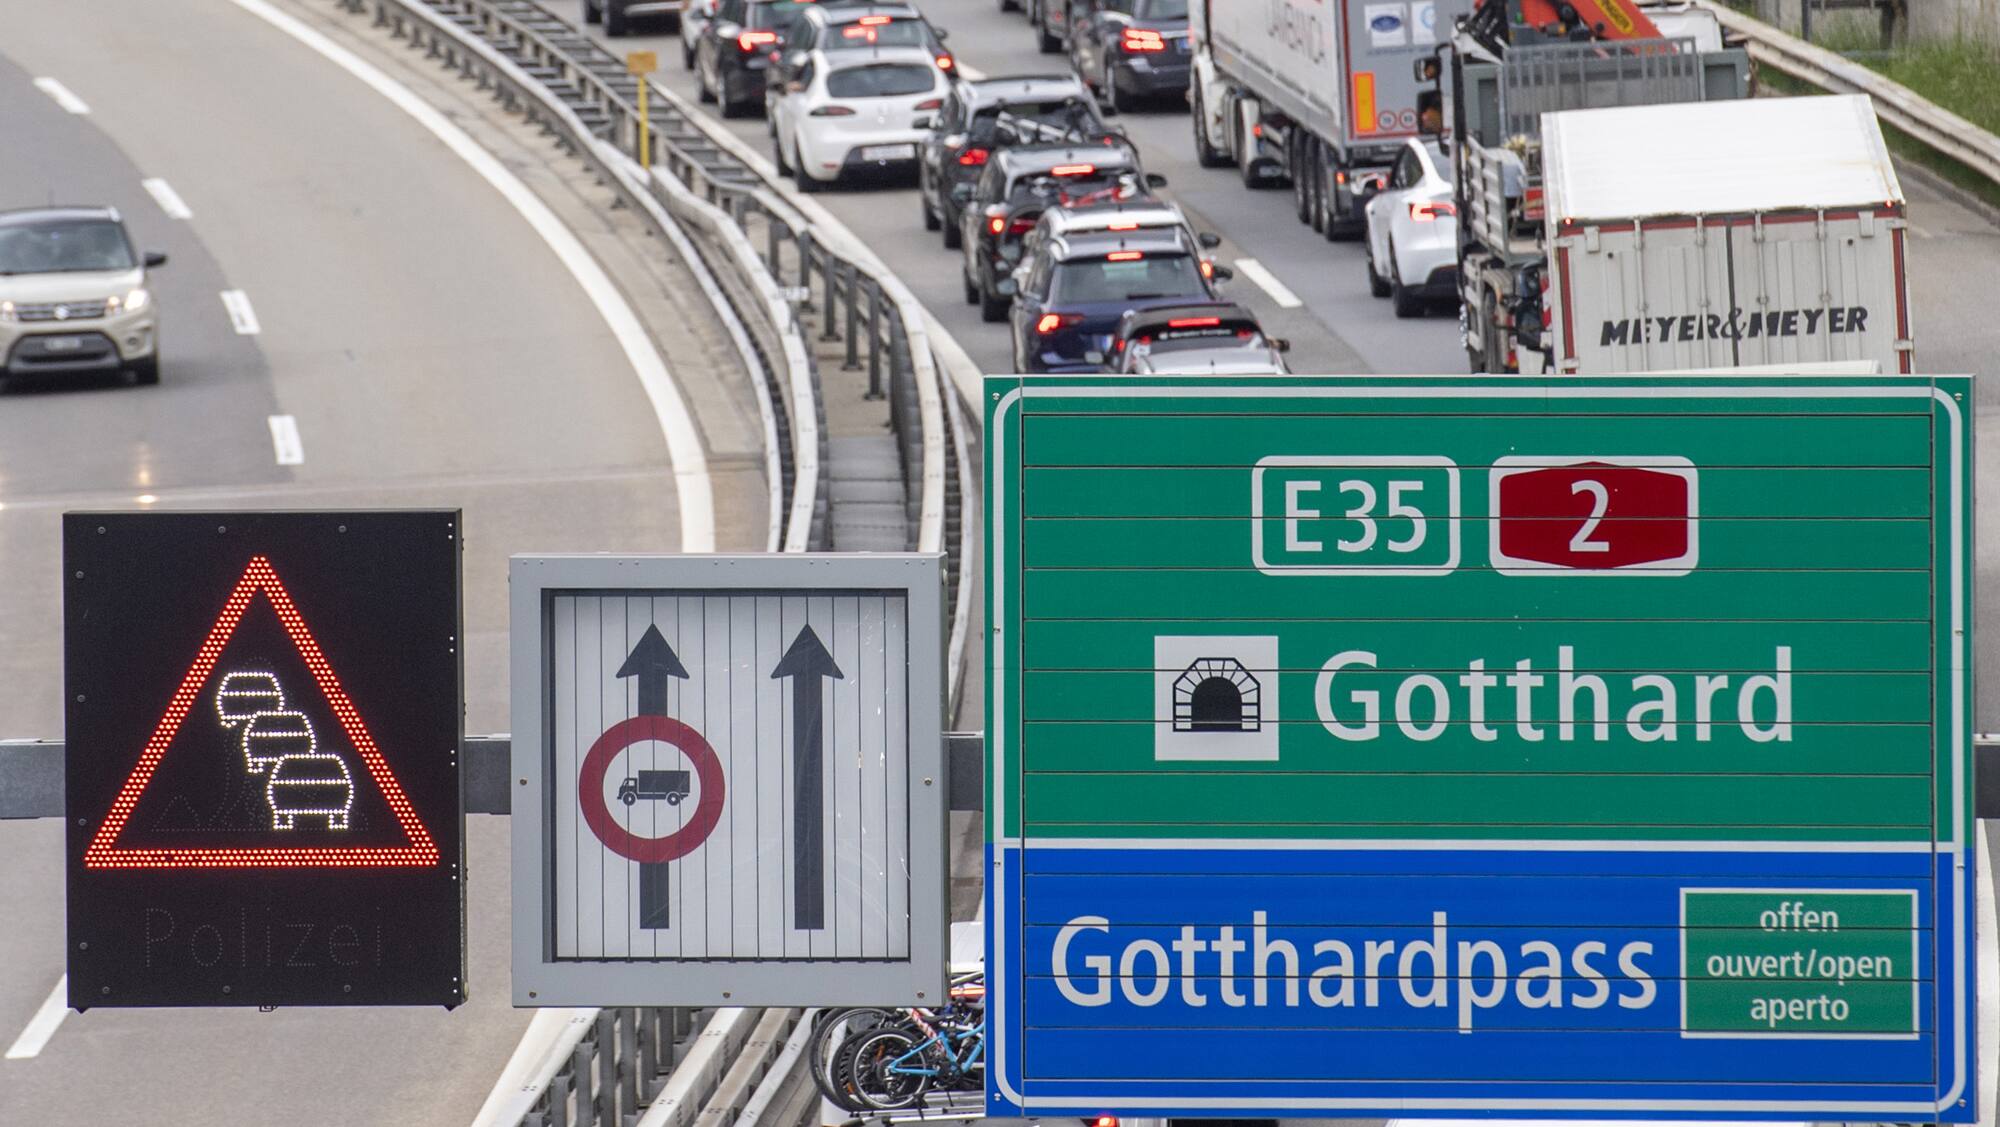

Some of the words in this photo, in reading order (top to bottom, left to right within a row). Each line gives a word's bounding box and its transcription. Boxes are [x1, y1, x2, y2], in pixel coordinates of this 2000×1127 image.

[1600, 306, 1868, 347] MEYER&MEYER
[1570, 480, 1609, 551] 2
[1315, 646, 1791, 742] Gotthard
[144, 907, 382, 968] Polizei
[1759, 901, 1839, 933] offen
[1053, 912, 1655, 1034] Gotthardpass
[1707, 949, 1893, 986] ouvert/open
[1750, 995, 1849, 1028] aperto
